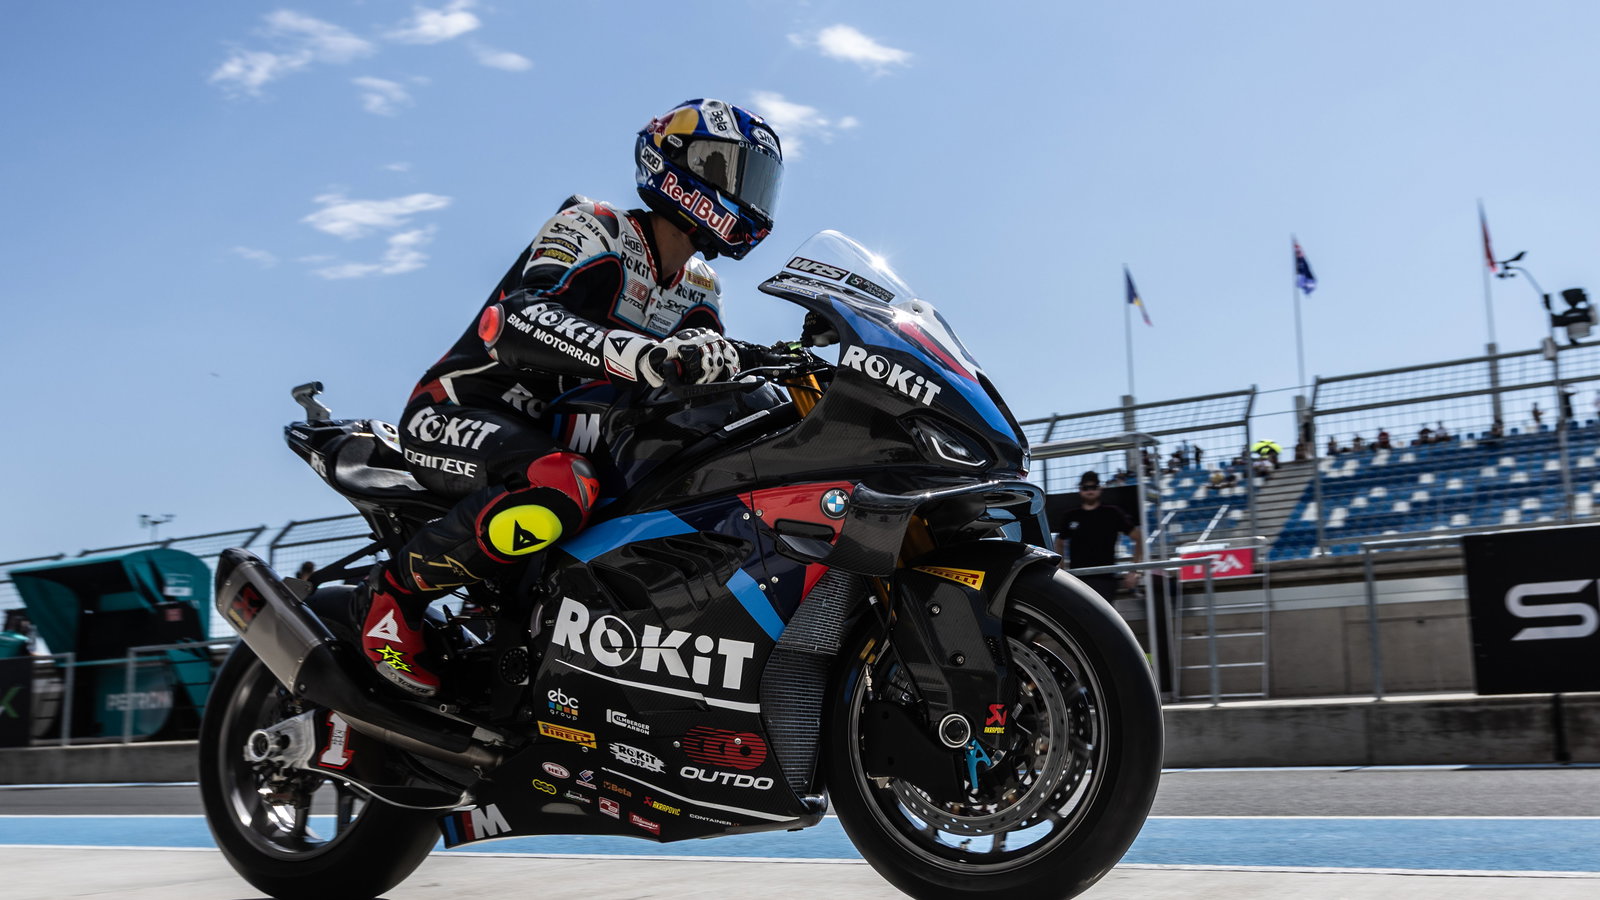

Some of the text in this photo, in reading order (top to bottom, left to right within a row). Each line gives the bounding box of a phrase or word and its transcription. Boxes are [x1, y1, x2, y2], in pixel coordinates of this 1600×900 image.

[643, 148, 660, 170] SHOEI
[661, 172, 737, 238] Red Bull
[624, 235, 643, 253] SHOEI
[789, 258, 847, 279] WRS
[506, 313, 600, 367] BMW MOTORRAD
[404, 447, 477, 478] DAINESE
[1504, 578, 1600, 641] S
[547, 688, 579, 709] ebc
[549, 709, 578, 721] group
[319, 711, 349, 766] 1
[541, 724, 592, 746] PIRELLI
[630, 758, 646, 768] OFF
[680, 766, 774, 790] OUTDO
[611, 783, 632, 798] Beta
